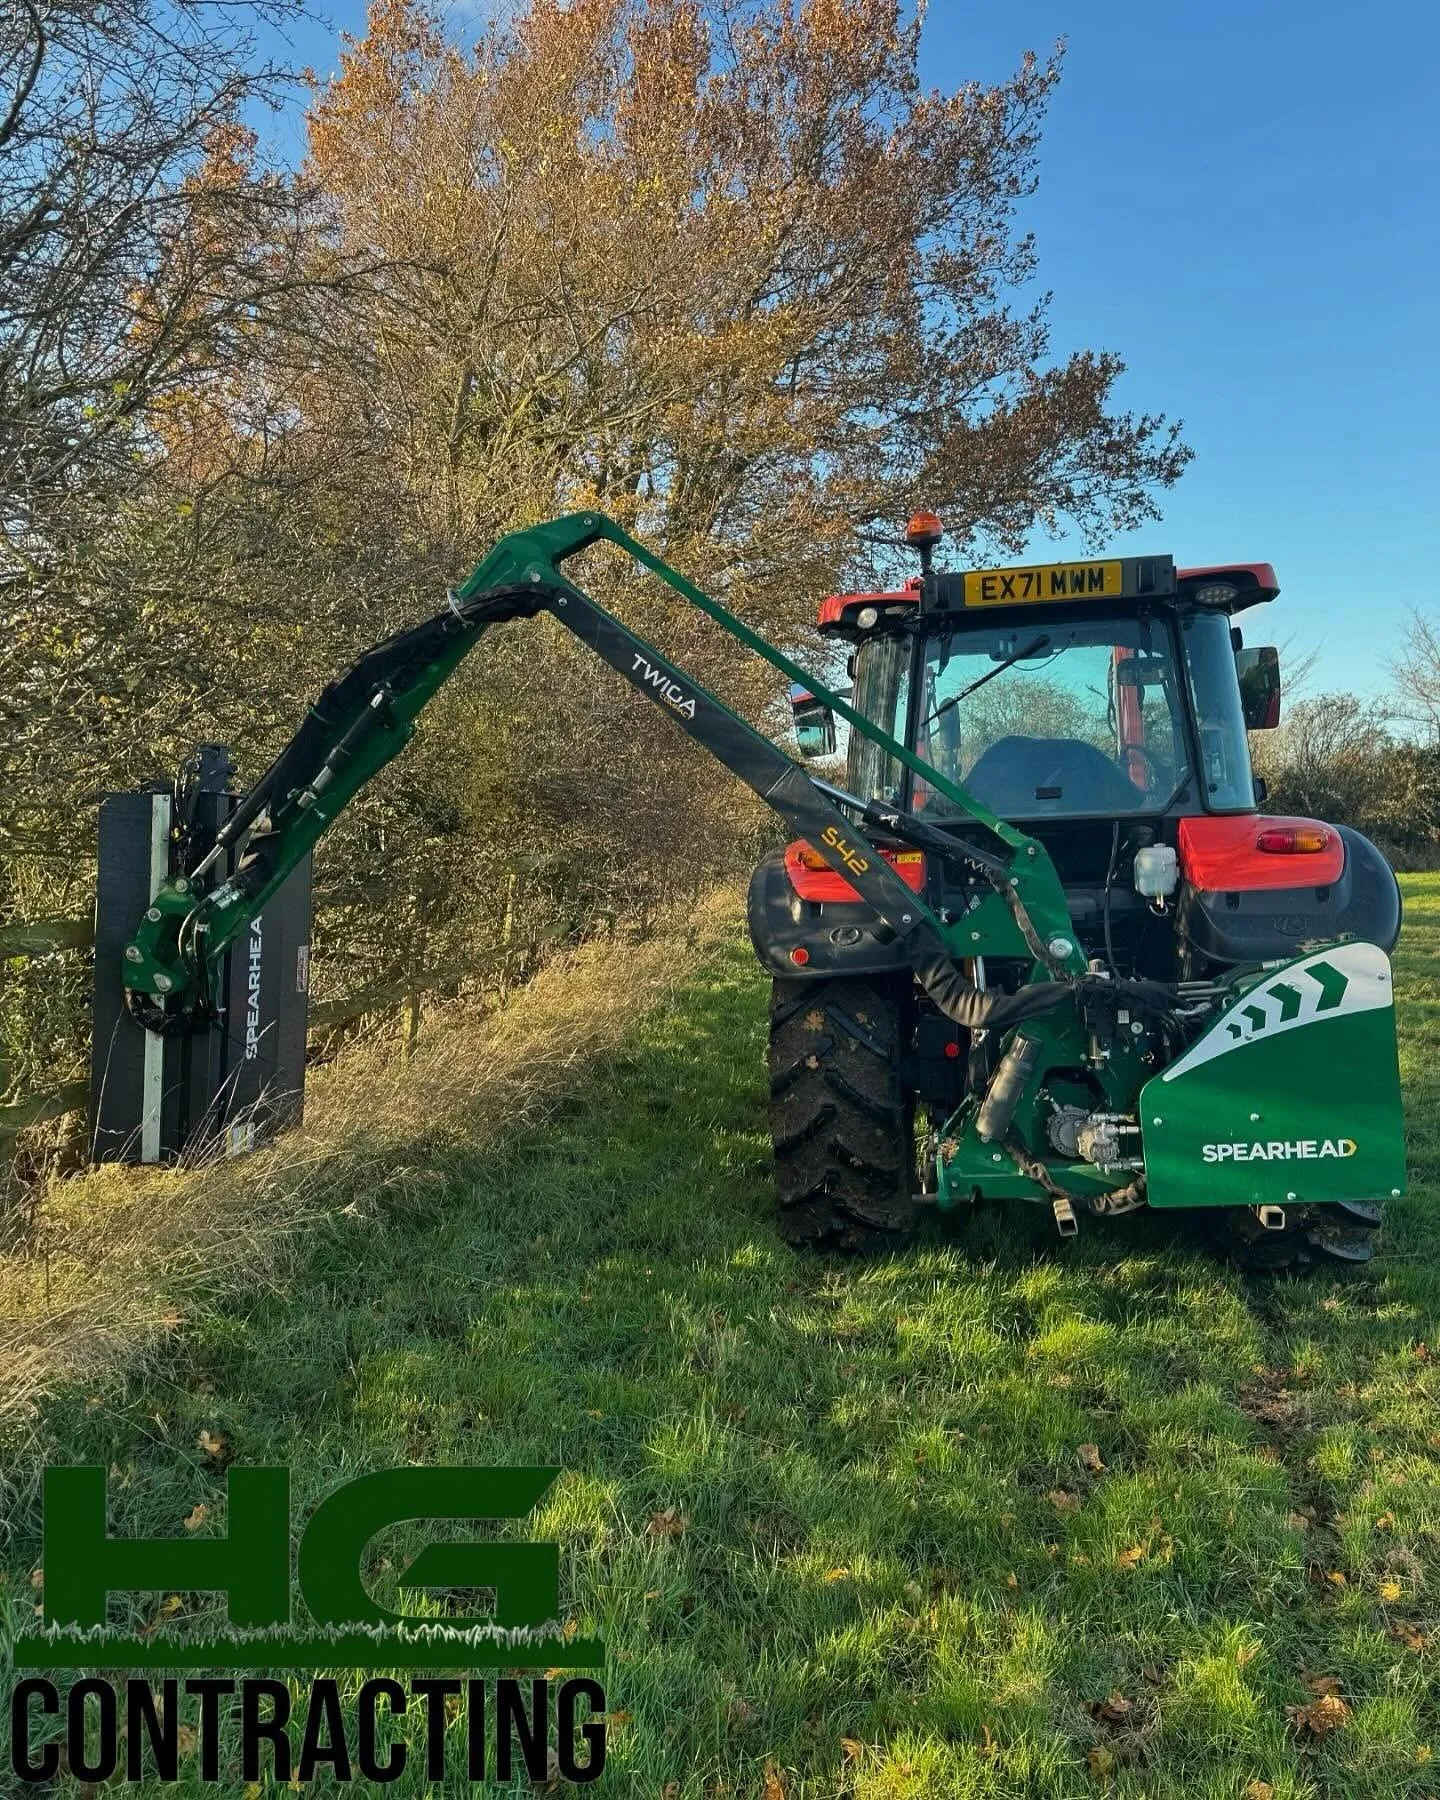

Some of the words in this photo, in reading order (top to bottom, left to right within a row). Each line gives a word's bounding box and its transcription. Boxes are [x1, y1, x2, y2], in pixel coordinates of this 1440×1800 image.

[981, 573, 1042, 600] EX71
[1051, 568, 1104, 595] MWM
[245, 915, 263, 1060] SPEARHEA
[1202, 1139, 1357, 1163] SPEARHEAD
